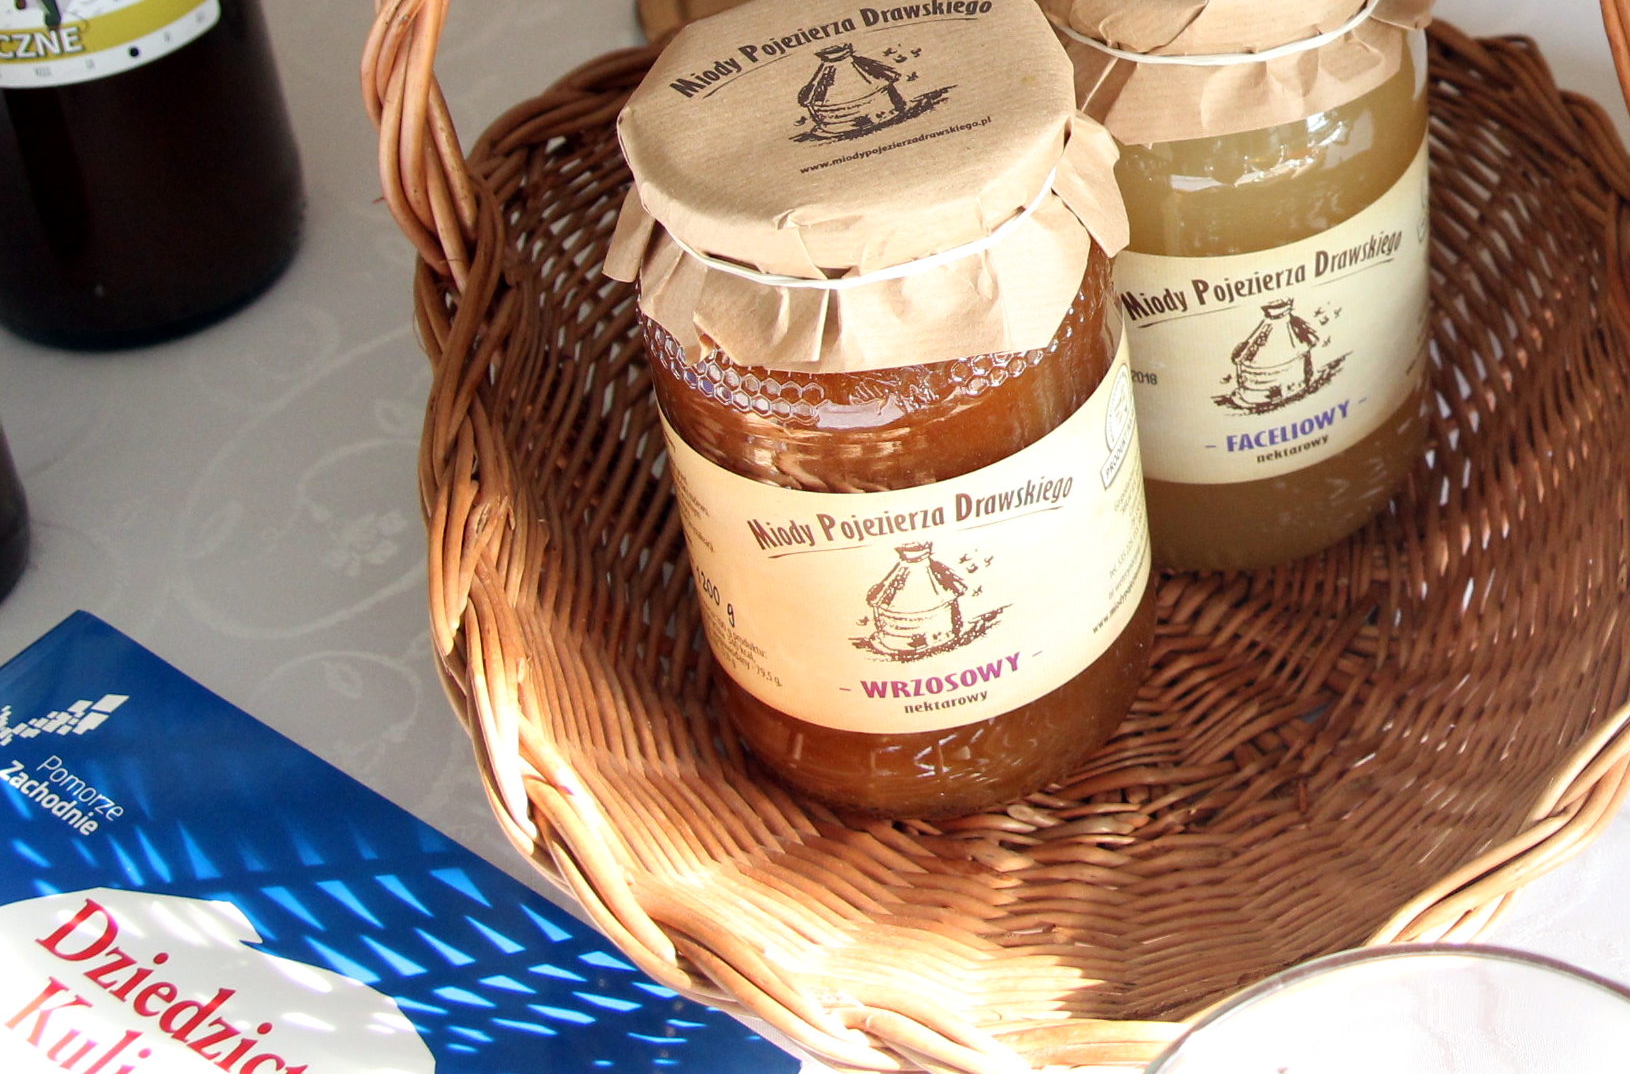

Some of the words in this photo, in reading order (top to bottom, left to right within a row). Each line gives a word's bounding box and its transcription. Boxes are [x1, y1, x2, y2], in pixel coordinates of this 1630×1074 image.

[668, 57, 741, 99] Miody
[737, 17, 857, 64] Pojezierza
[798, 115, 993, 174] www.miodypojezierzadrawskiego.pl
[1120, 287, 1188, 322] Miody
[1191, 264, 1306, 306] Pojezierza
[1314, 229, 1403, 278] Drawskiego
[1131, 369, 1158, 386] 2018
[1226, 399, 1351, 453] FACELIOWY
[1256, 434, 1329, 464] nektarowy
[746, 518, 816, 551] Miody
[821, 506, 945, 543] Pojezierza
[955, 473, 1075, 521] Drawskiego
[727, 602, 736, 628] g
[860, 650, 1022, 700] WRZOSOWY
[903, 688, 990, 714] nektarowy
[0, 759, 99, 837] Zachodnie
[37, 754, 125, 822] Pomorze
